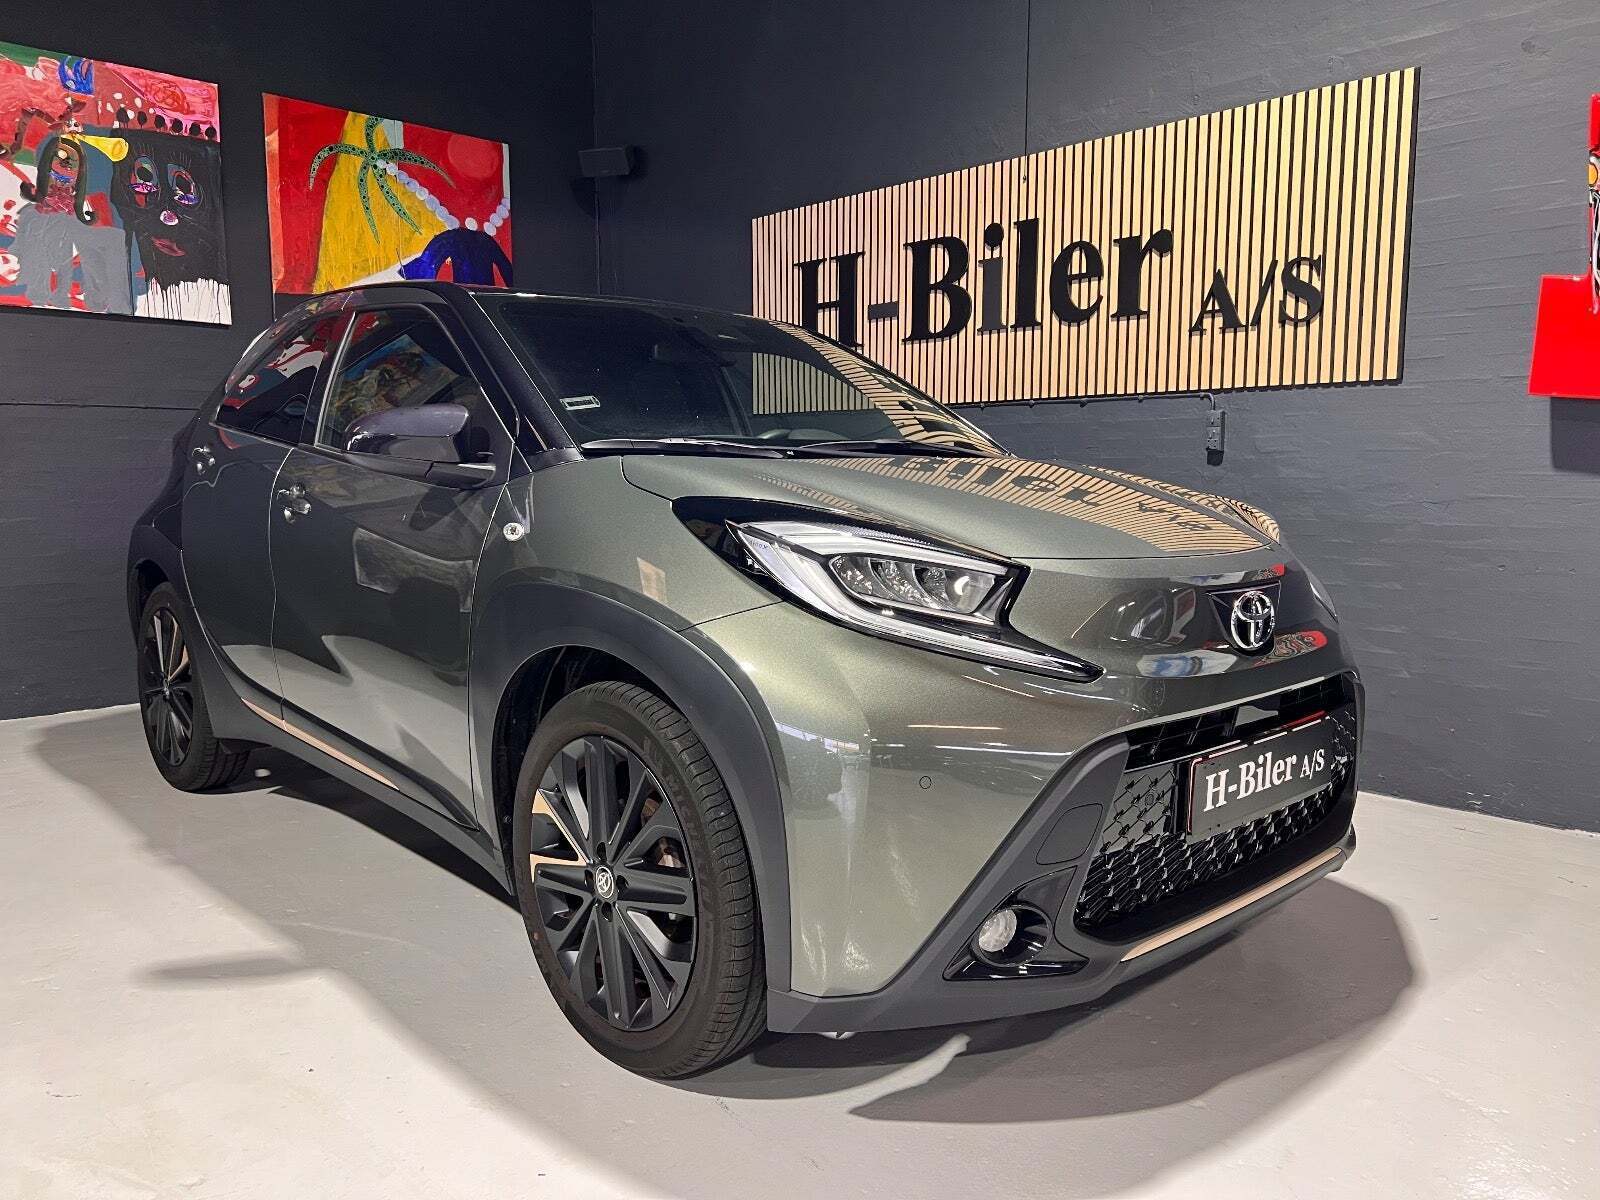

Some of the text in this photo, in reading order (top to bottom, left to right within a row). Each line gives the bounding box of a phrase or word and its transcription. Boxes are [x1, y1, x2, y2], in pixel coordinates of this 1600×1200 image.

[793, 217, 1324, 347] H-Biler A/S
[1203, 749, 1325, 812] H-Biler A/S
